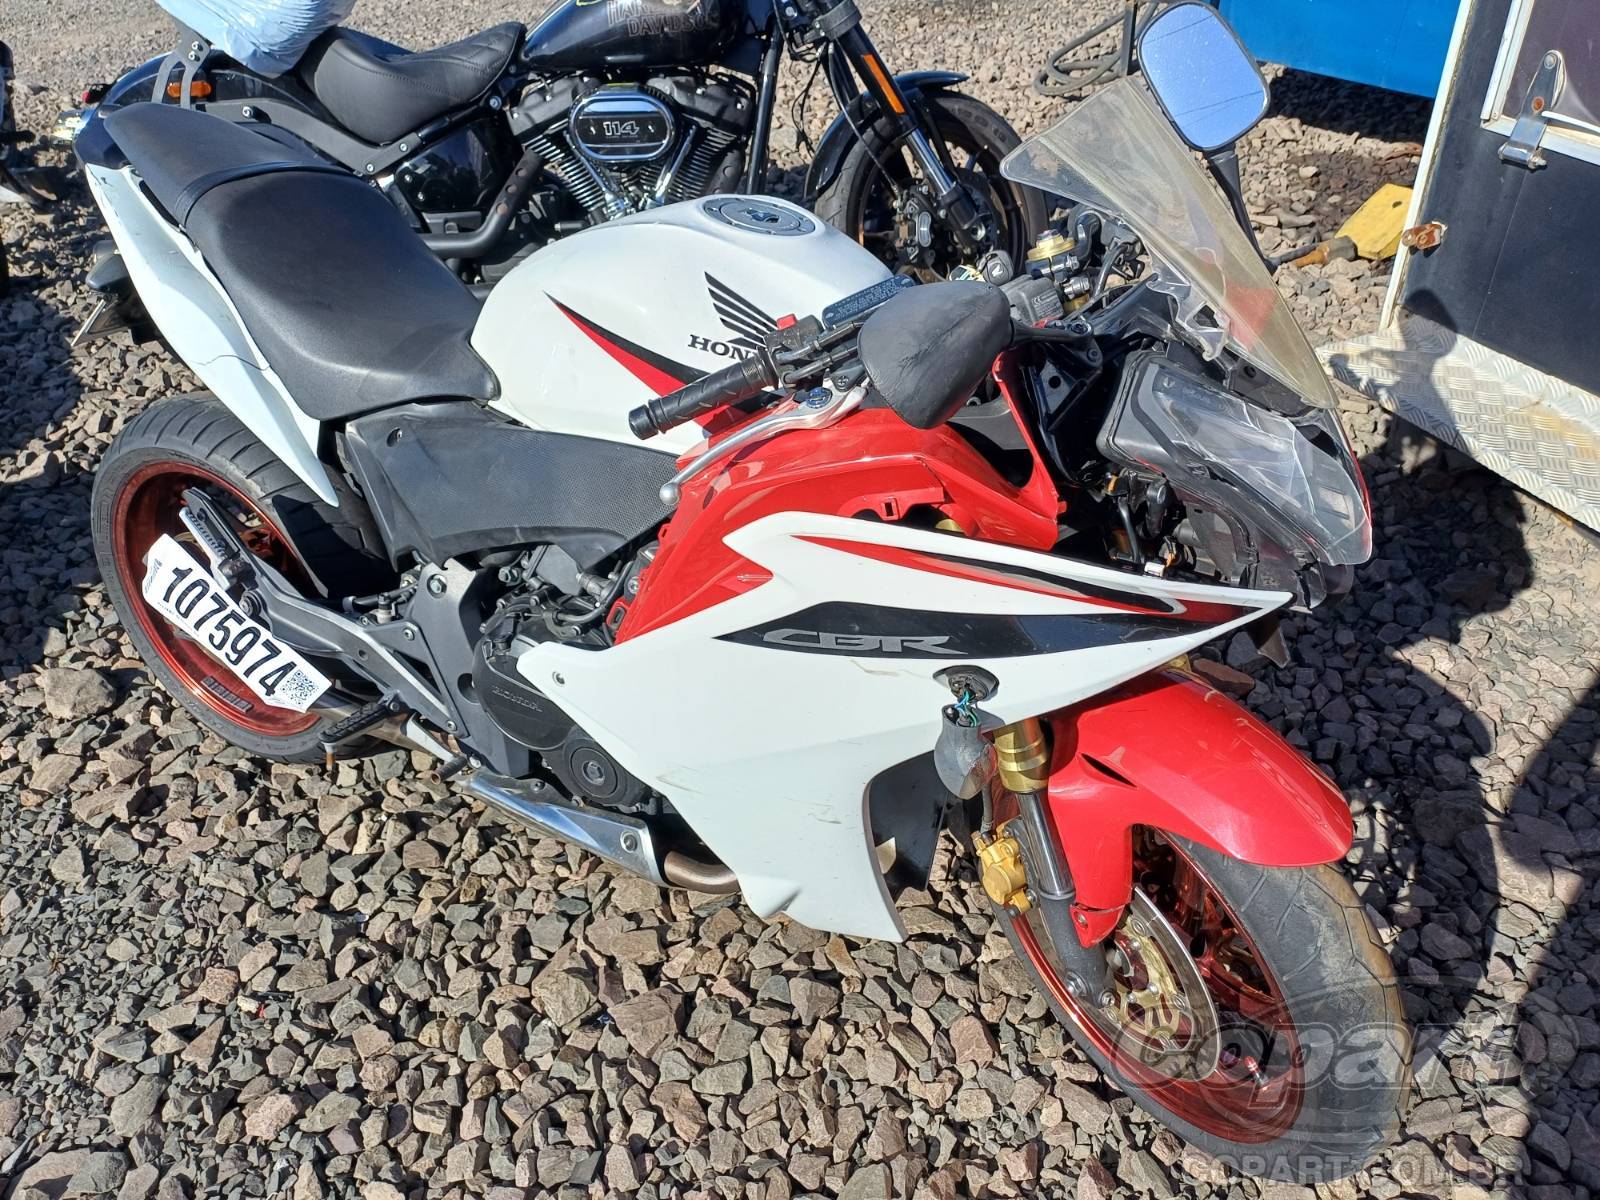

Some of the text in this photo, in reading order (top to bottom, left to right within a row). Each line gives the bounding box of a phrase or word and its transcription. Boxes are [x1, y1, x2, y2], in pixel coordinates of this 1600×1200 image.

[603, 120, 640, 136] 114
[688, 334, 753, 361] HON
[162, 567, 297, 697] 1075974
[763, 628, 969, 655] CBR
